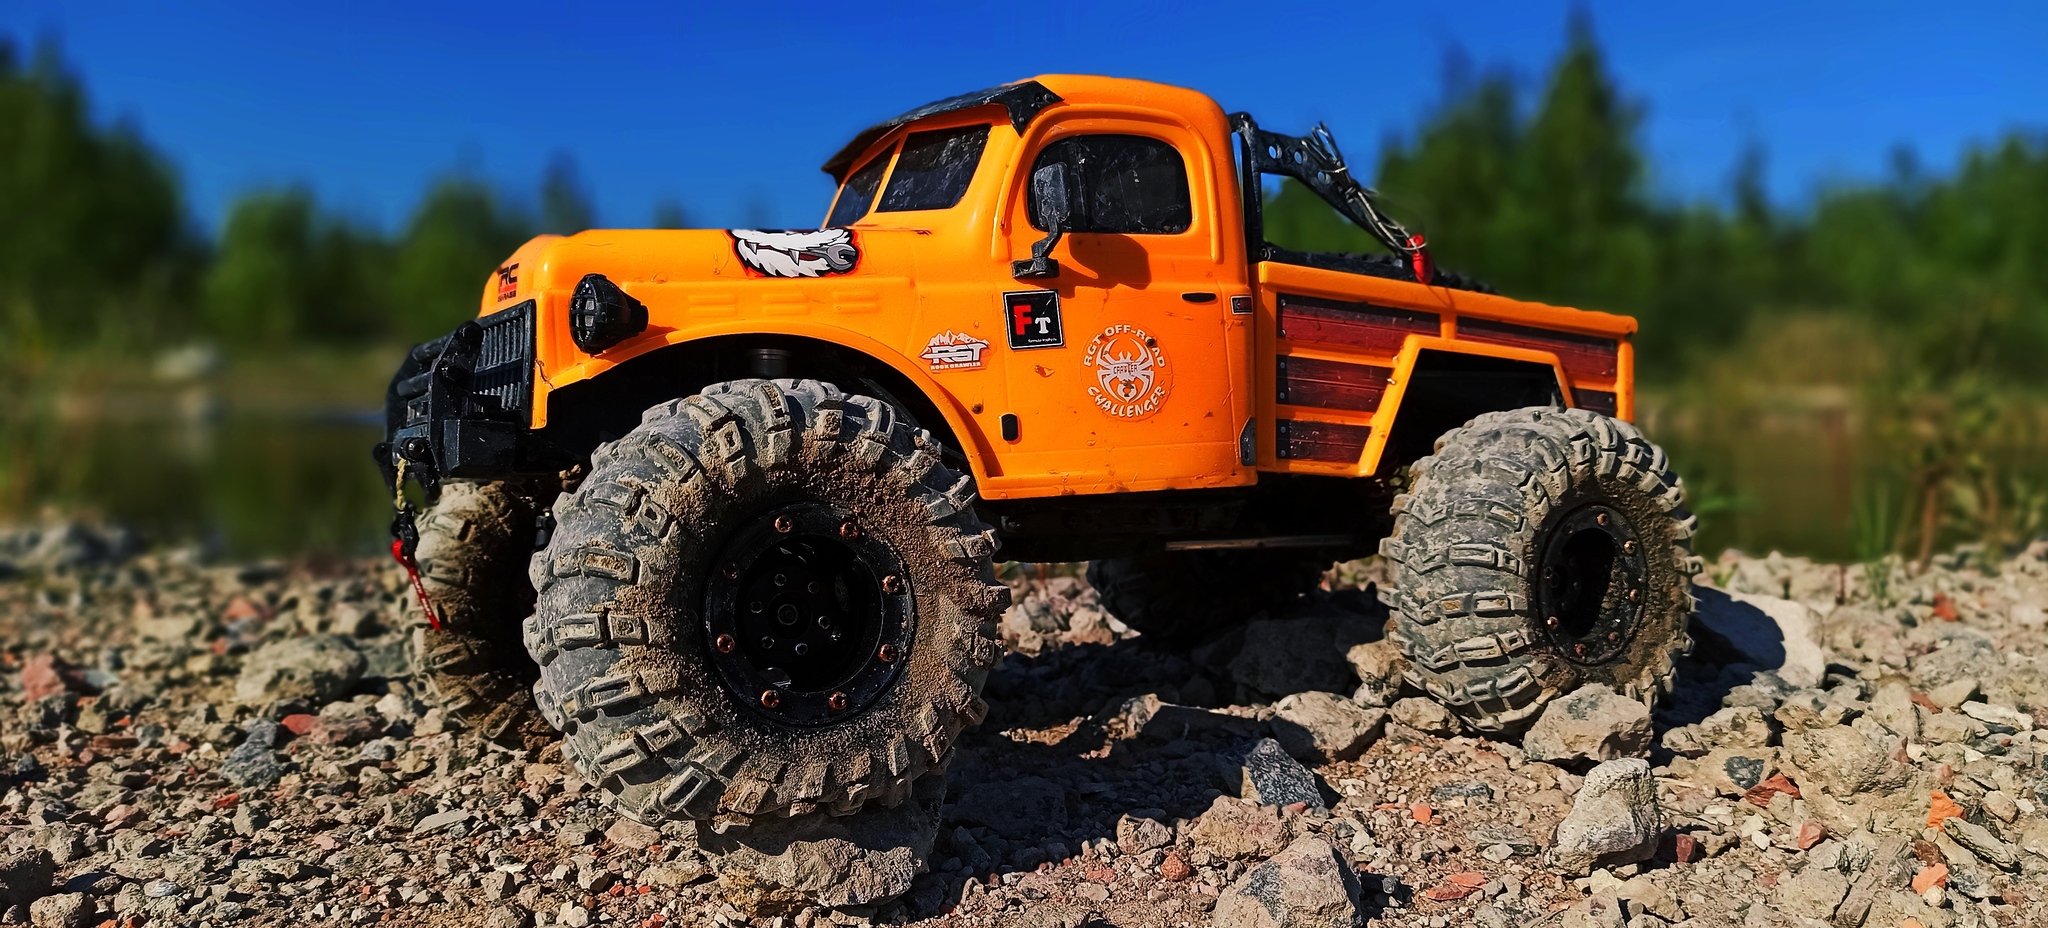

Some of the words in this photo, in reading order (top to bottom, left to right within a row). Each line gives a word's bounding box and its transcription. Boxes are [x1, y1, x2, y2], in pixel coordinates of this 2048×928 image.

[921, 342, 988, 364] RGT
[1083, 334, 1104, 367] RGT
[949, 361, 981, 369] CRAWLER
[1087, 386, 1165, 417] CHALLENGER
